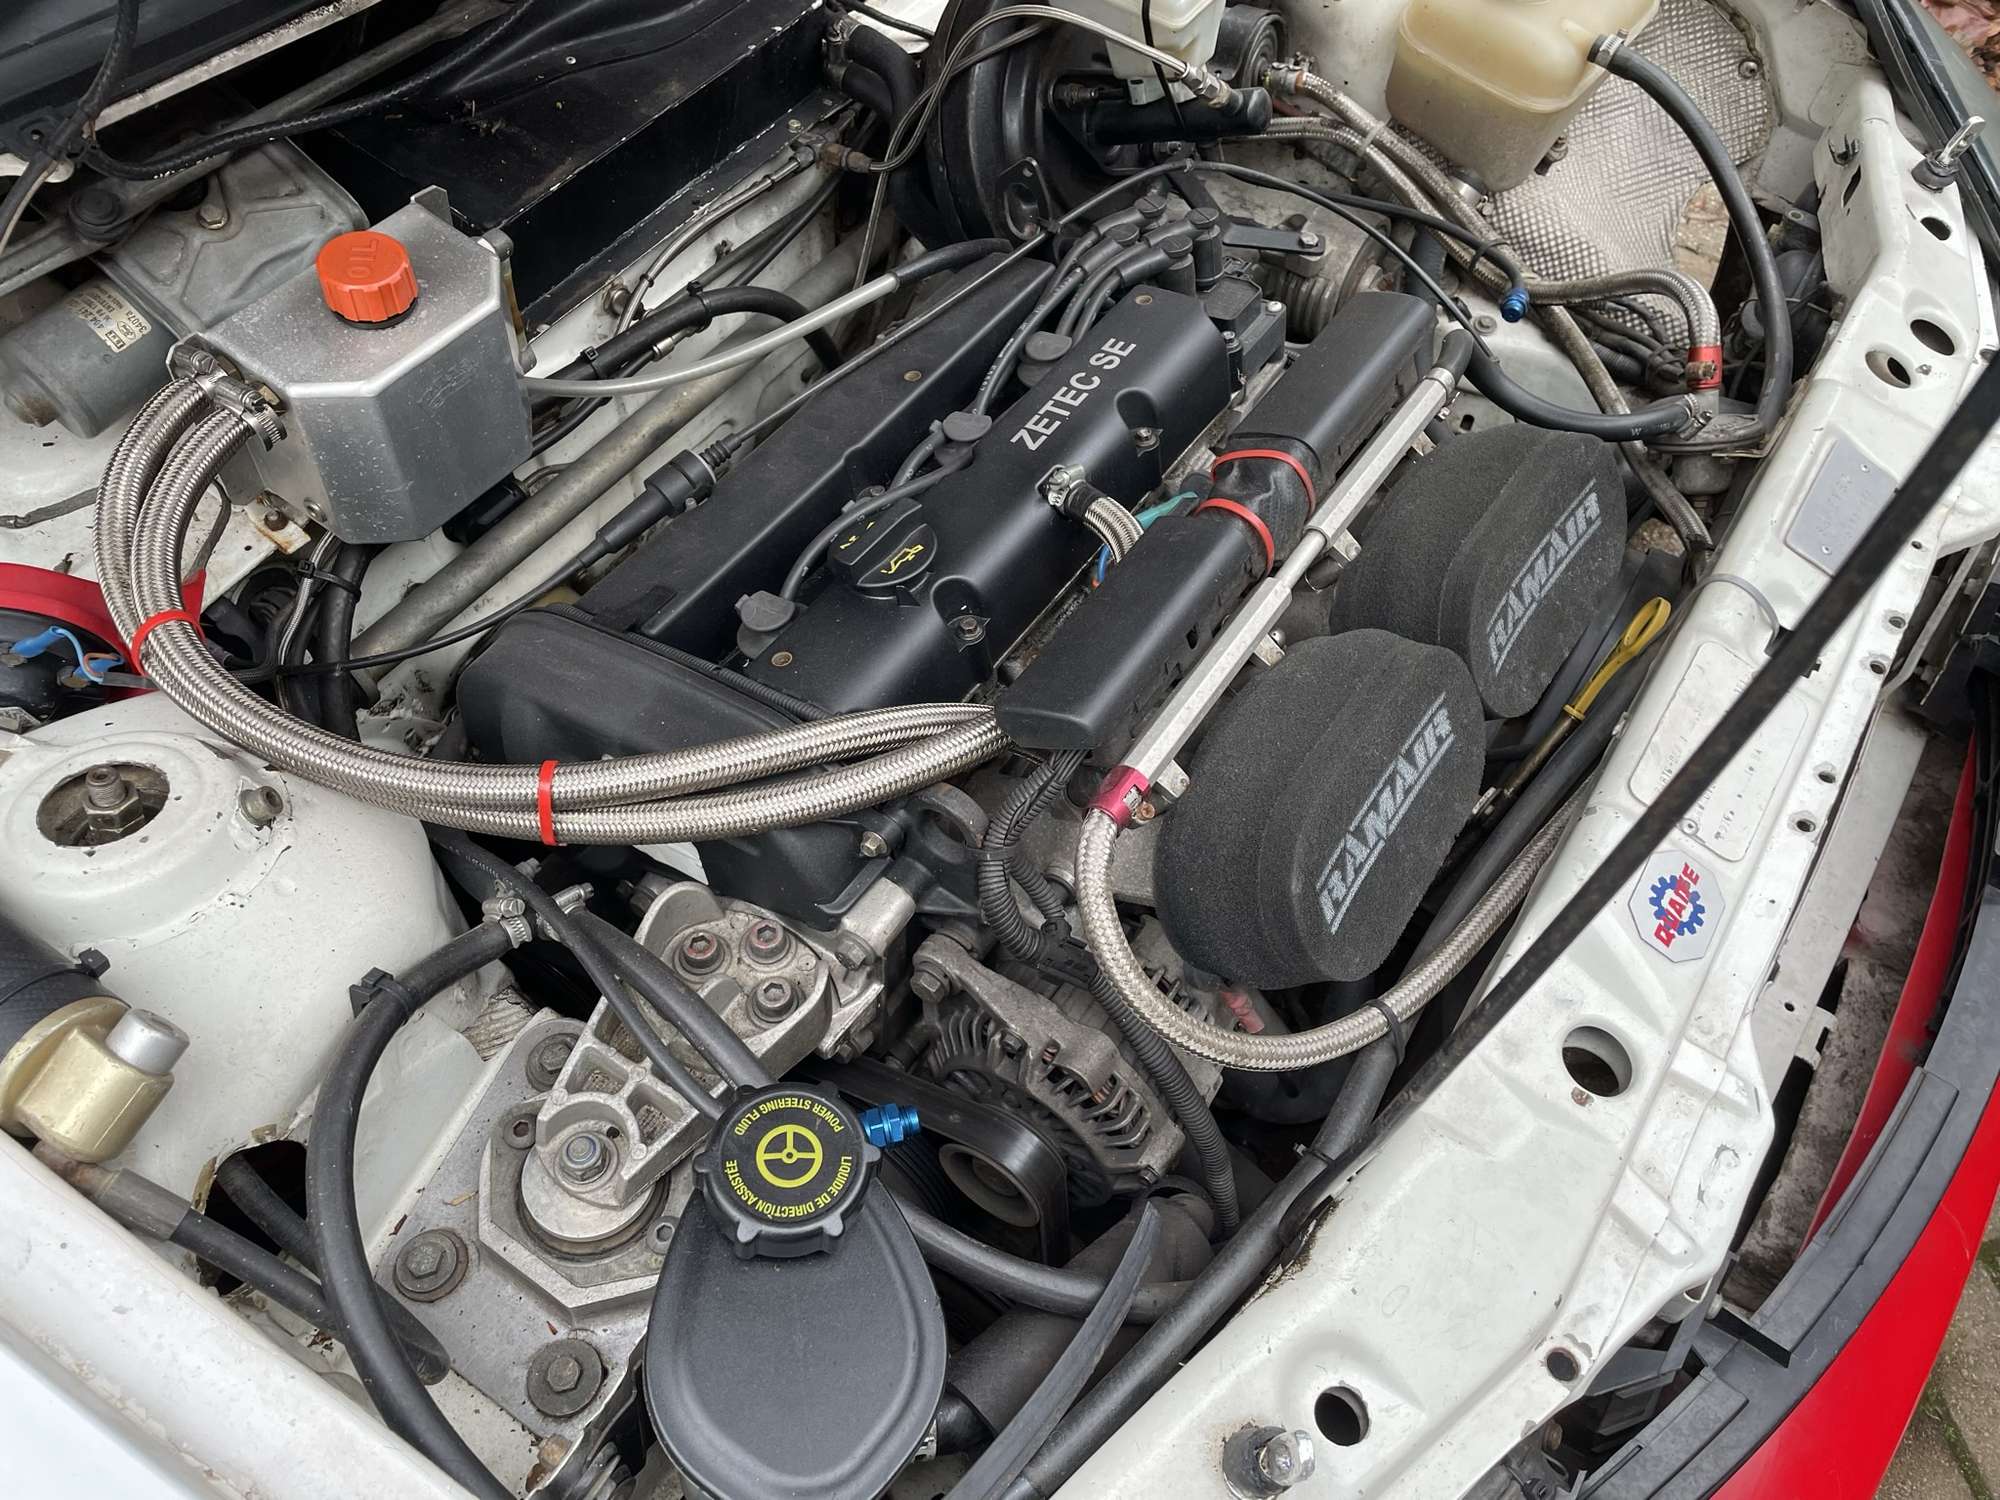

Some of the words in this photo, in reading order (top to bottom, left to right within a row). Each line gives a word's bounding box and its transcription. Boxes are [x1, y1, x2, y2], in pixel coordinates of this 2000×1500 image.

[346, 239, 380, 279] OIL
[1010, 372, 1101, 451] ZETEC
[1089, 337, 1137, 370] SE
[1487, 490, 1601, 667] RAMAIR
[1318, 706, 1453, 927] RAMAIR
[734, 1107, 761, 1136] FLUID
[759, 1097, 812, 1114] STEERING
[812, 1100, 845, 1133] POWER
[829, 1156, 852, 1197] LIQUIDE
[755, 1201, 815, 1219] DIRECTION
[816, 1190, 832, 1208] DE
